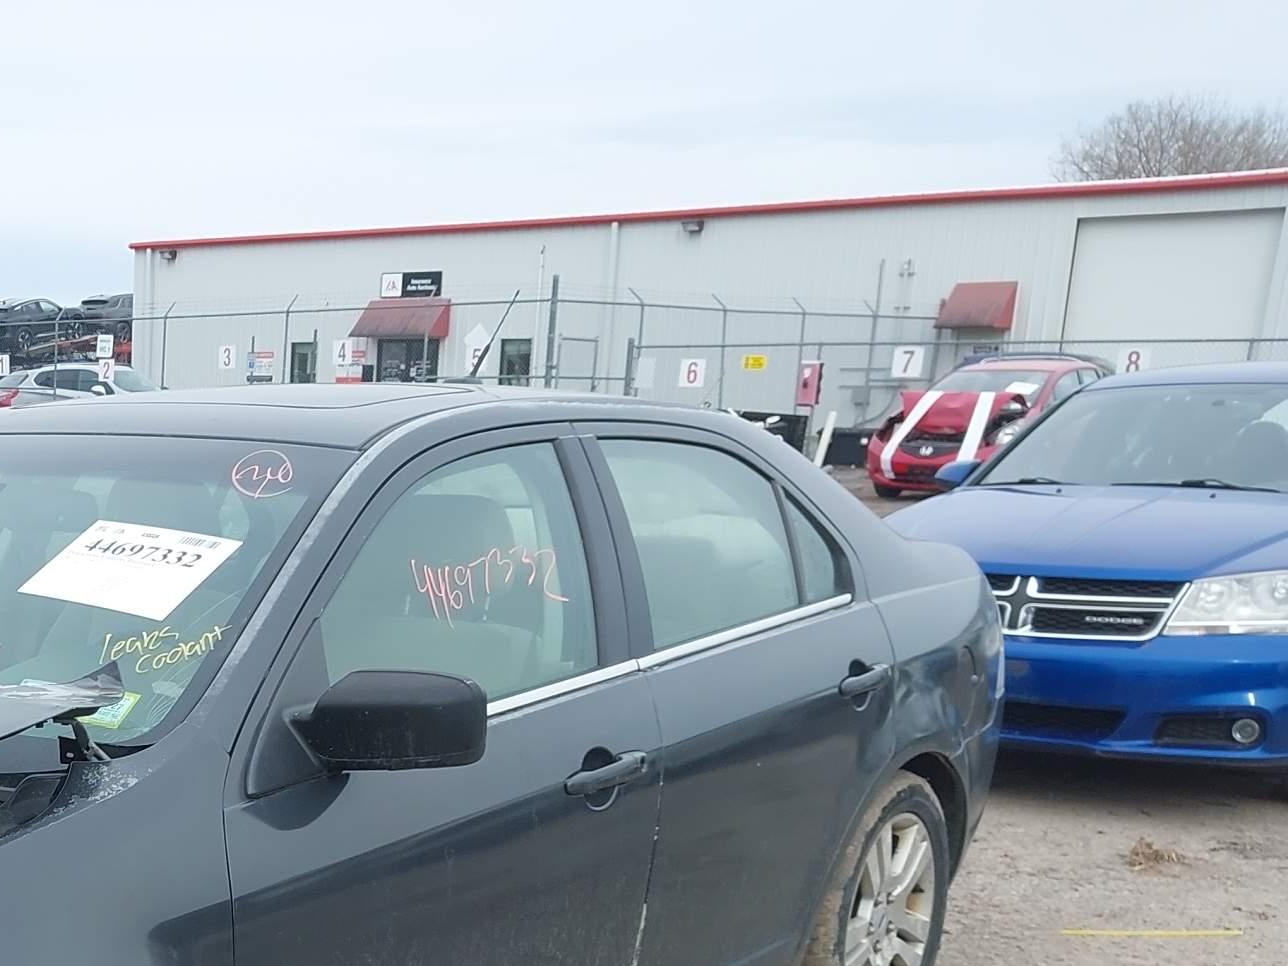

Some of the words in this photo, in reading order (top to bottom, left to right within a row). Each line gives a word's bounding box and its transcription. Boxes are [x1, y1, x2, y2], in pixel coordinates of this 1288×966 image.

[223, 347, 231, 367] 3
[338, 341, 347, 362] 4
[903, 350, 915, 373] 7
[1126, 351, 1140, 373] 8
[103, 361, 110, 379] 2
[687, 361, 698, 384] 6
[84, 538, 202, 568] 44697332
[410, 544, 569, 630] 44697332
